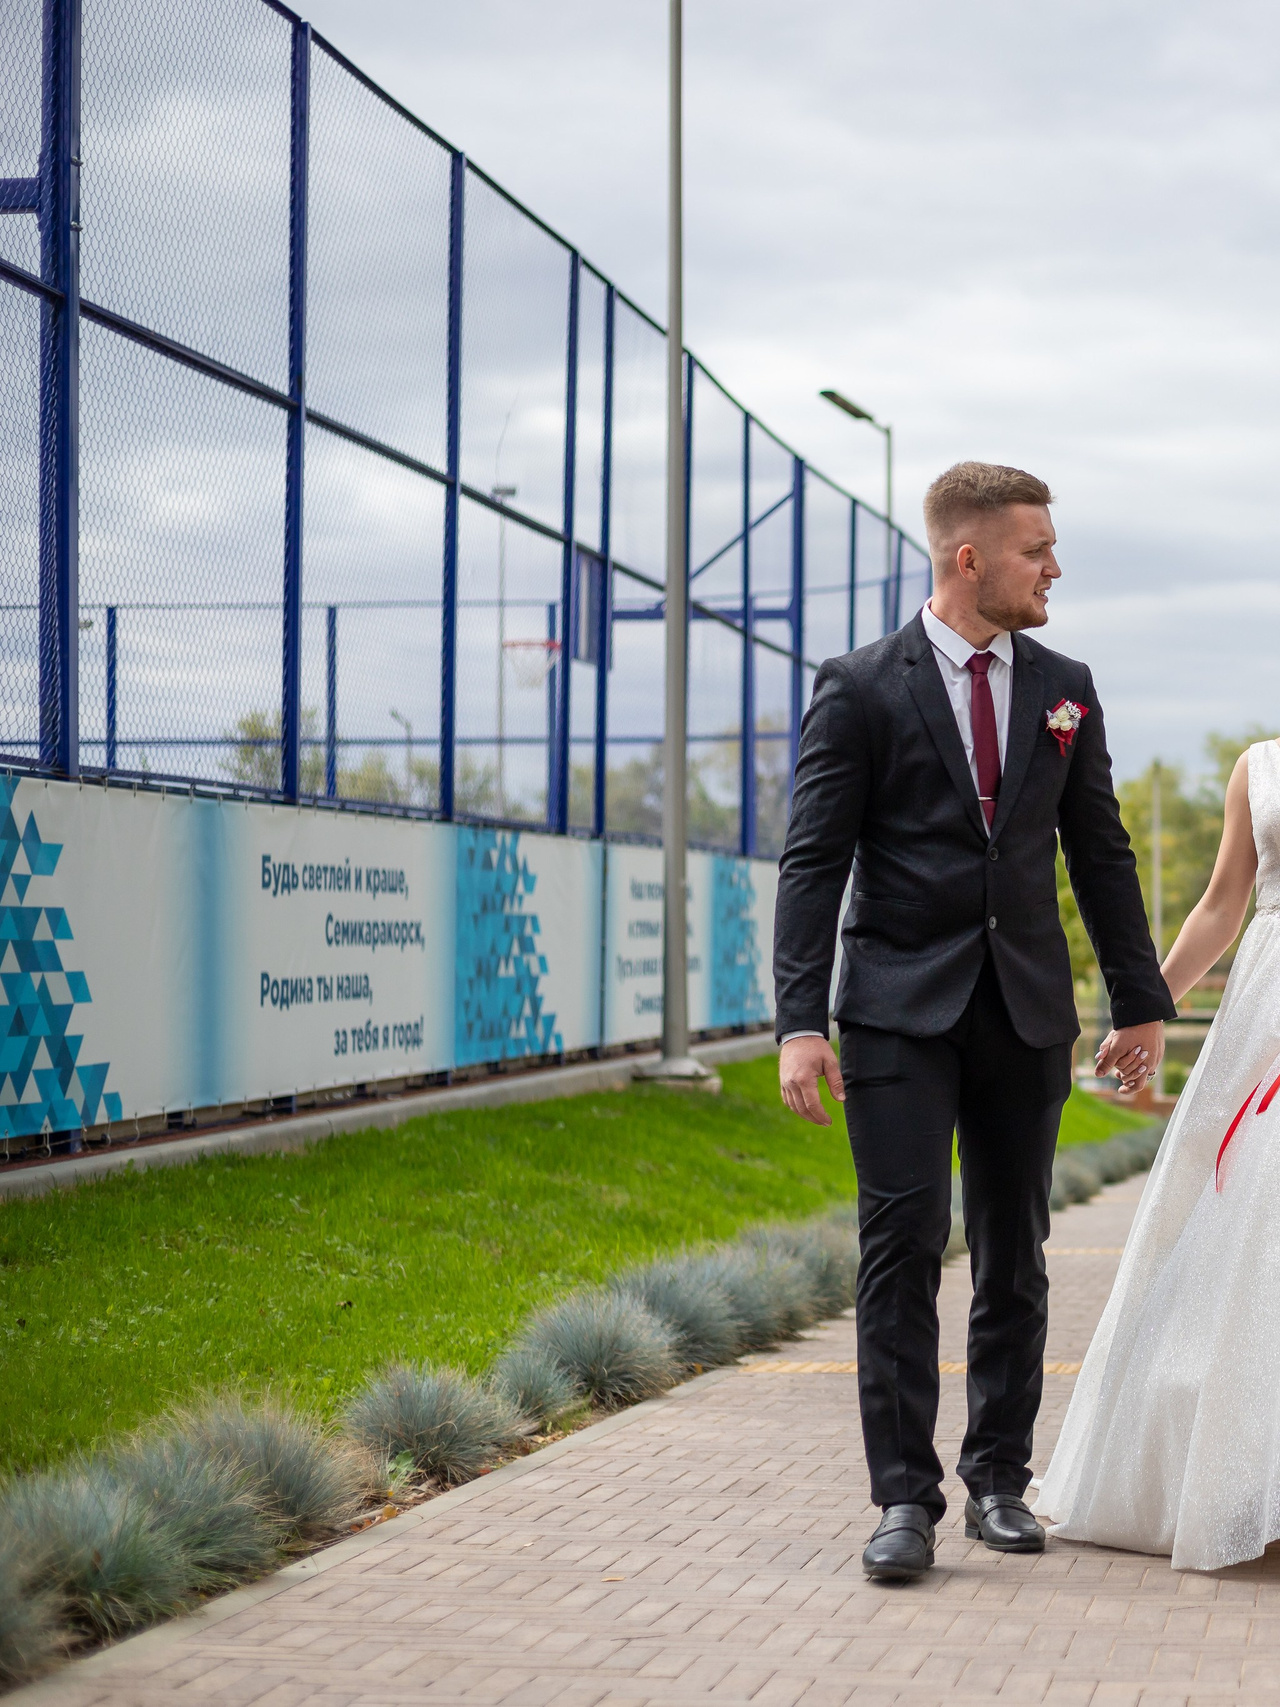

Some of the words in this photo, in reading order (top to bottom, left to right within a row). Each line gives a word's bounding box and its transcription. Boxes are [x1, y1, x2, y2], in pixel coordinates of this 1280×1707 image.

[261, 854, 299, 898] Будь
[302, 857, 351, 893] светлей
[355, 866, 362, 893] и
[366, 867, 409, 900] краше,
[325, 911, 425, 953] Семикаракорск,
[260, 971, 313, 1011] Родина
[316, 975, 333, 1002] ты
[336, 973, 373, 1005] наша,
[334, 1029, 347, 1056] за
[351, 1019, 379, 1053] тебя
[382, 1024, 389, 1050] я
[392, 1014, 424, 1053] горд!
